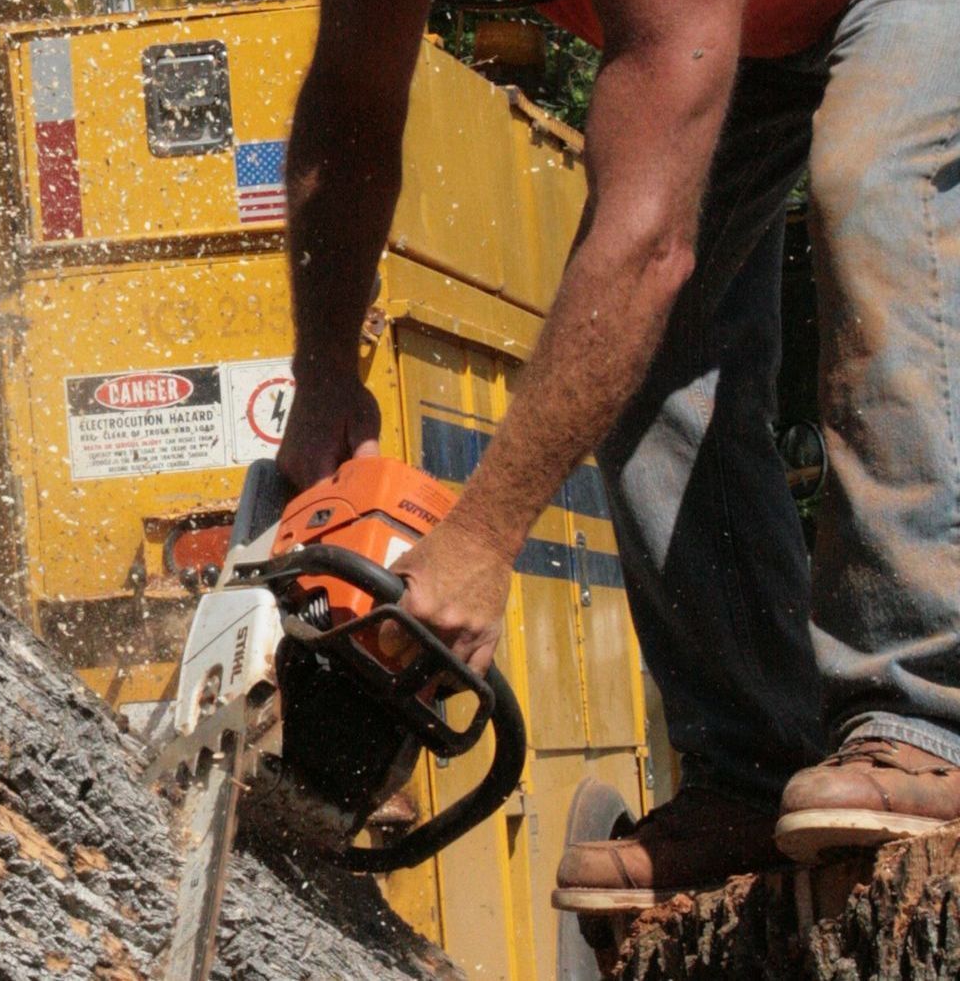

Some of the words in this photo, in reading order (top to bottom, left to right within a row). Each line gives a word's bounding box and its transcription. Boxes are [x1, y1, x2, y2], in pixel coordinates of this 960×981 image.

[107, 377, 180, 405] DANGER
[79, 413, 163, 431] ELECTROCUTION
[169, 410, 214, 425] HAZARD
[229, 625, 248, 685] STIHL
